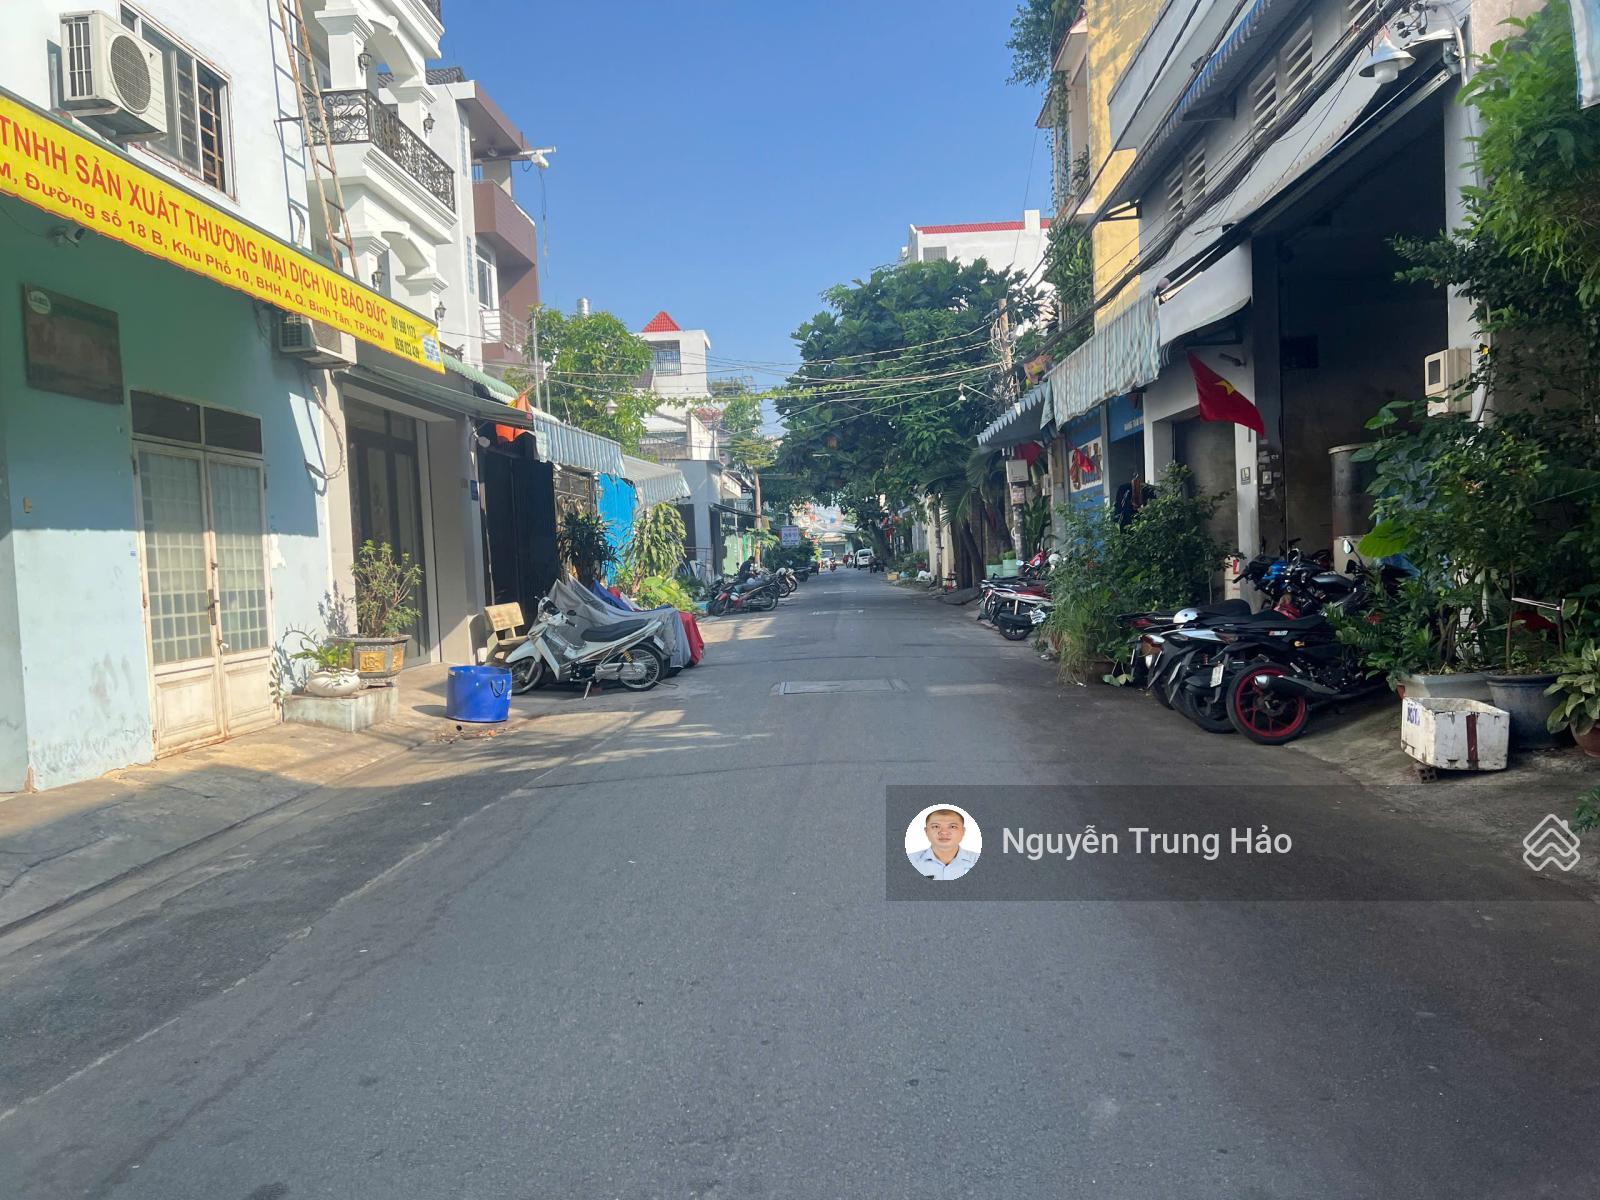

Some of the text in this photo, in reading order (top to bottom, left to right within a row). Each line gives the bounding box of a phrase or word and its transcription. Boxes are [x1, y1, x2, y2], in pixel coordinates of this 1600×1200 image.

[0, 114, 68, 176] TNHH
[75, 154, 122, 201] SẢN
[127, 179, 180, 228] XUẤT
[185, 209, 258, 264] THƯƠNG
[261, 247, 287, 280] MẠI
[290, 260, 320, 294] DỊCH
[322, 277, 338, 306] VỤ
[365, 299, 388, 326] ĐỨC
[24, 172, 95, 219] Đường
[101, 209, 122, 228] số
[128, 220, 147, 239] 18
[172, 239, 201, 263] Khu
[205, 254, 232, 275] Phố
[256, 276, 281, 296] BHH
